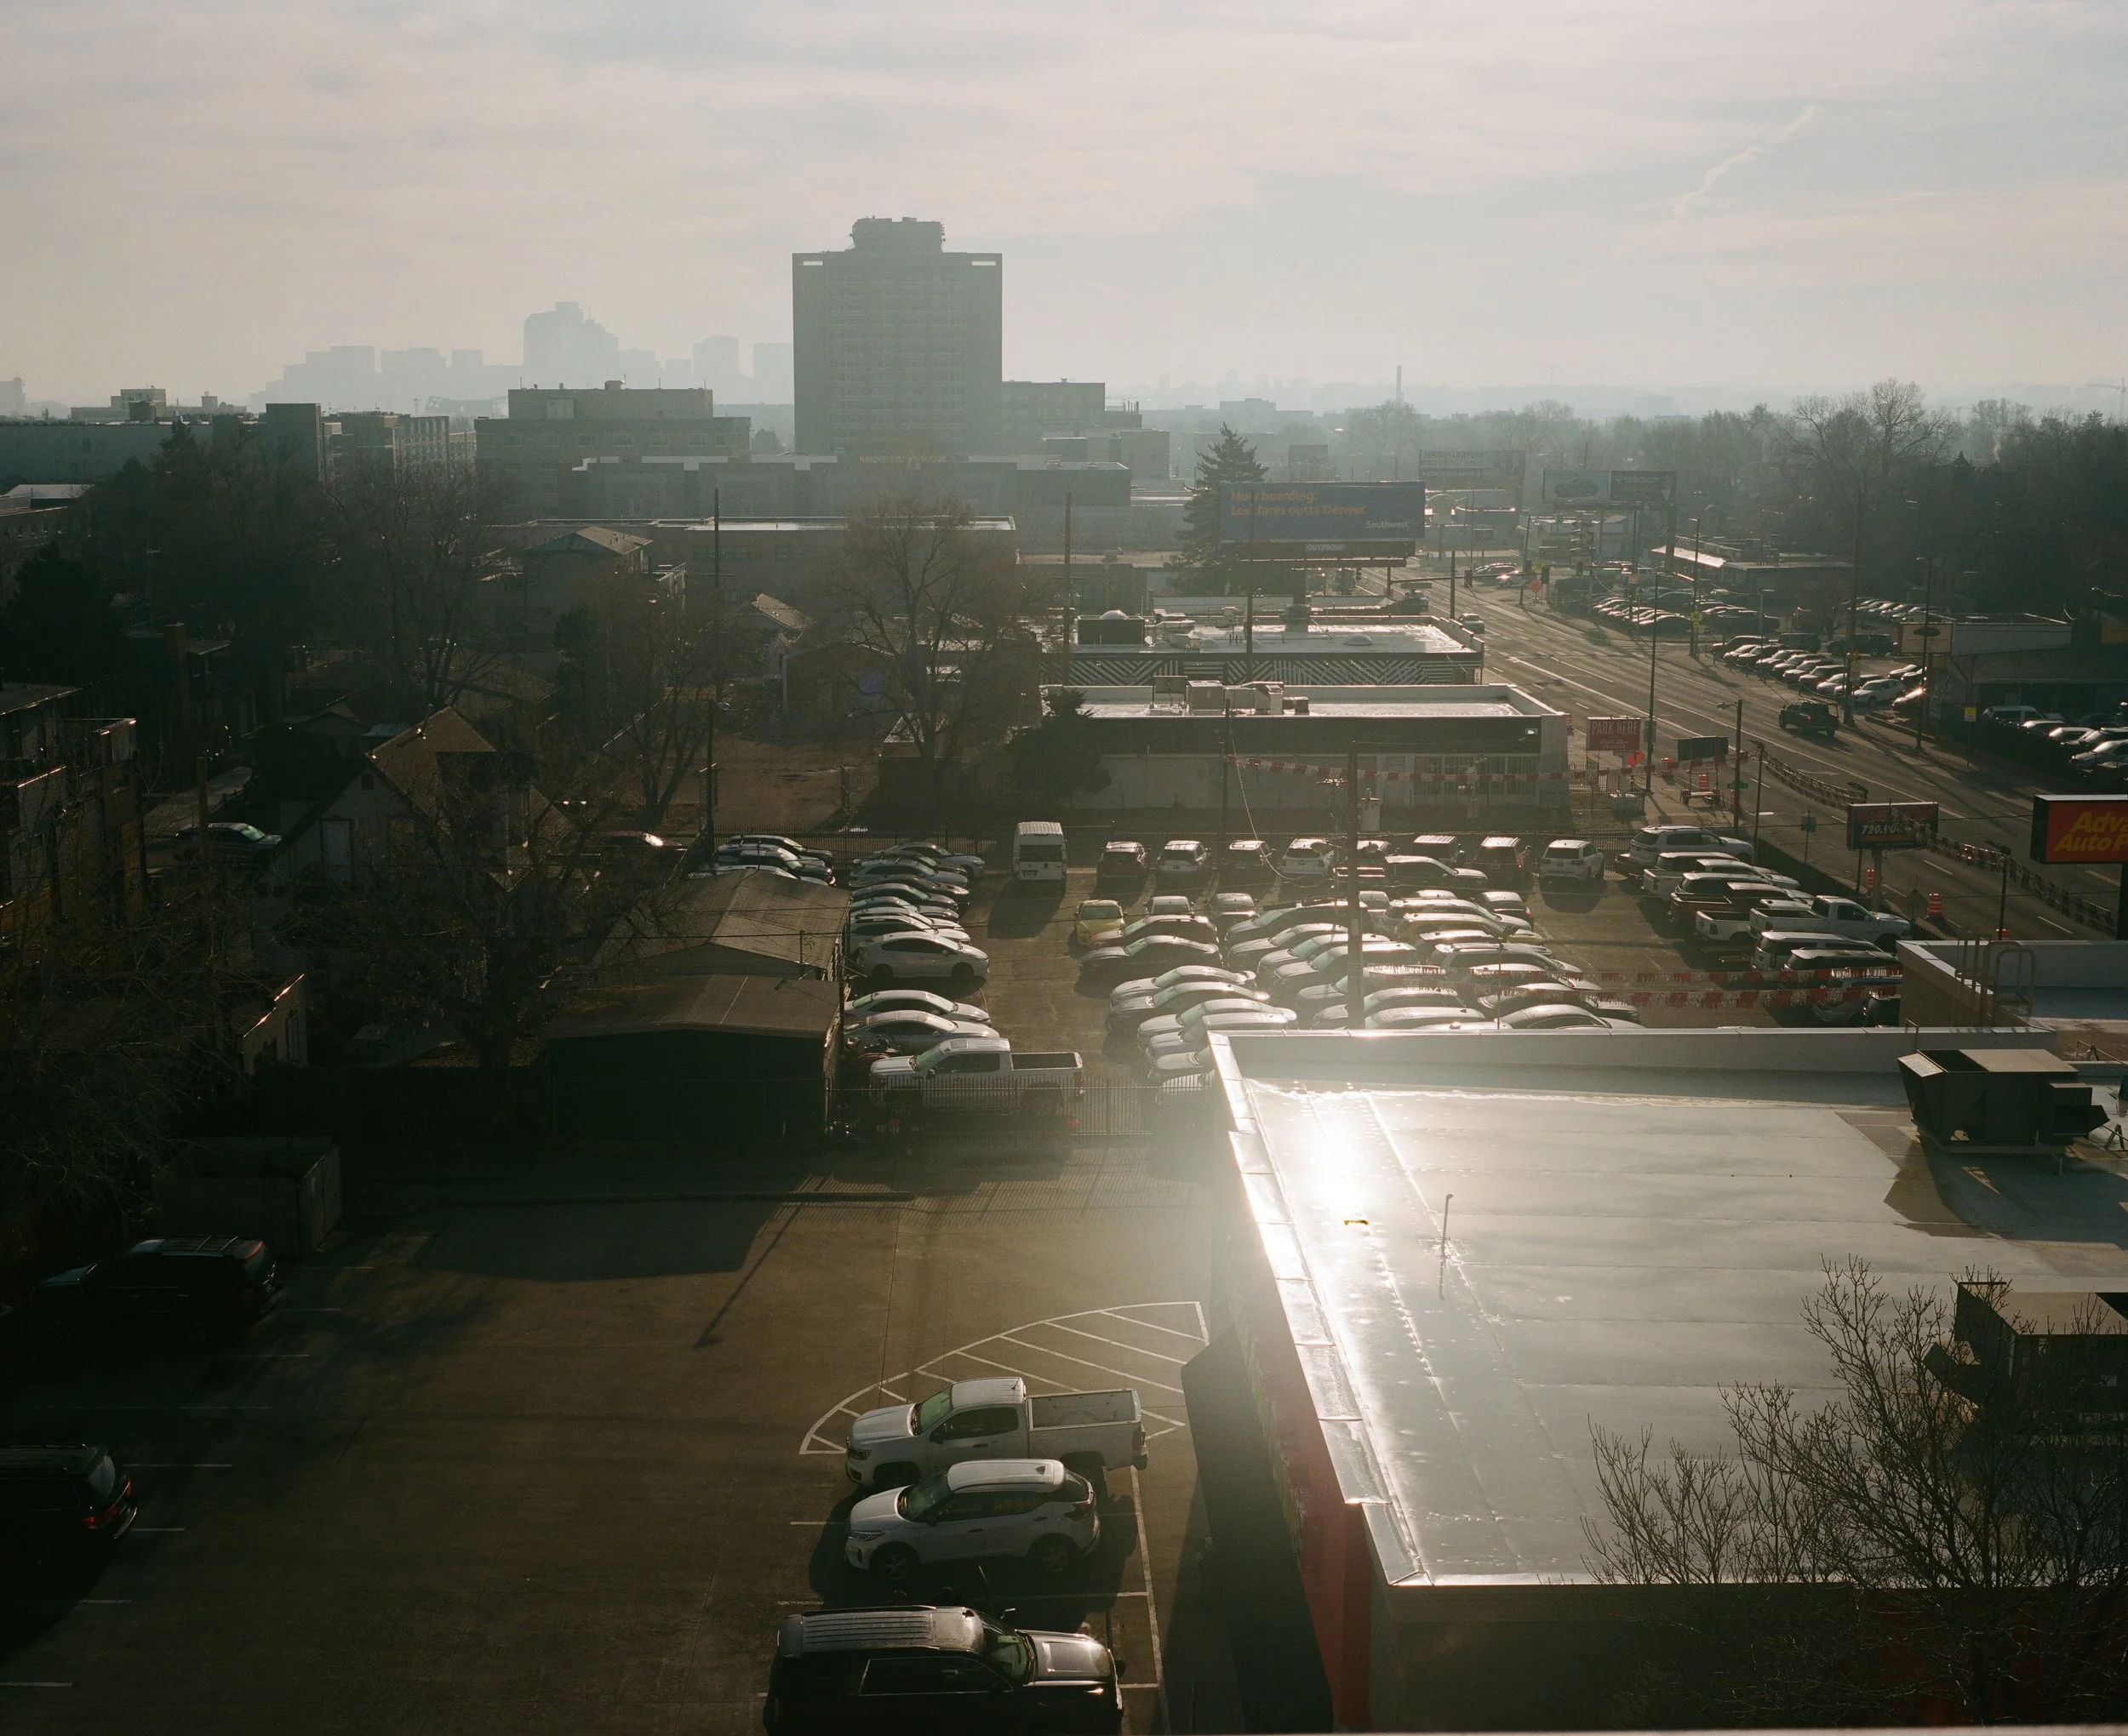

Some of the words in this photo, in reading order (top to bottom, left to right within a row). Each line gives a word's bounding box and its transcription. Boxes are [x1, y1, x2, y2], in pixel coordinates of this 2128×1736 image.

[1366, 520, 1409, 528] Southwest
[1592, 721, 1614, 735] PARK
[1616, 721, 1639, 734] HERE
[2053, 833, 2112, 852] Auto
